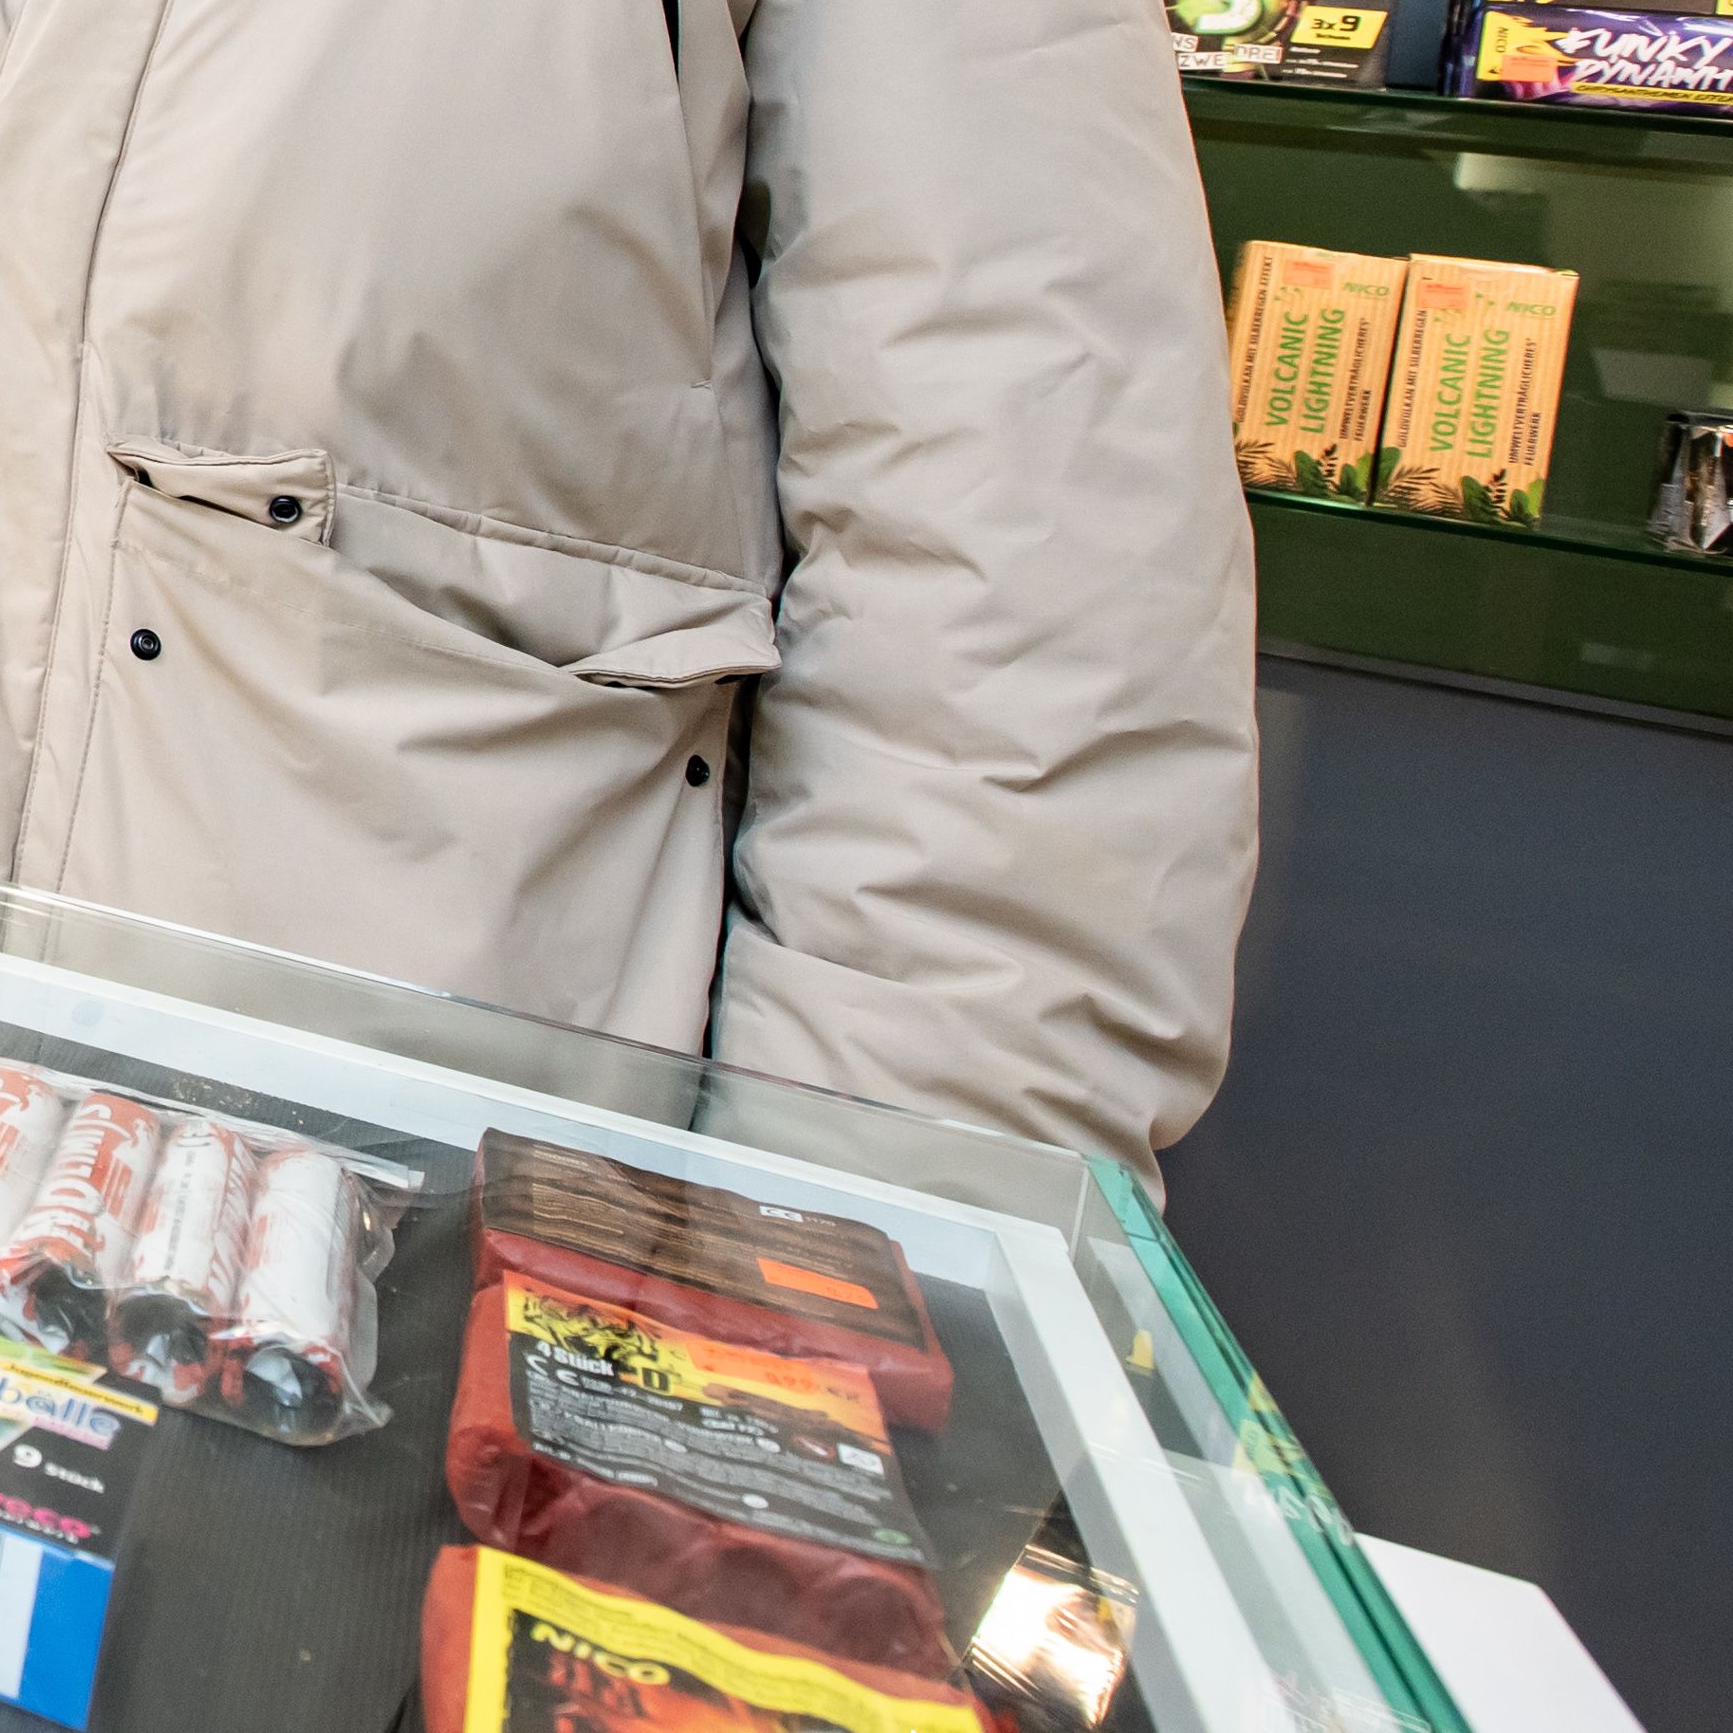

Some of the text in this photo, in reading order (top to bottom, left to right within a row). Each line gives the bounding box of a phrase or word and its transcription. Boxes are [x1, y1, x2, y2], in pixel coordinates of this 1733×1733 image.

[1340, 14, 1361, 32] 9
[1496, 26, 1509, 54] NICO
[1555, 27, 1733, 70] FUNKY
[1344, 281, 1390, 297] NICO
[1507, 301, 1557, 317] NICO
[1264, 312, 1310, 427] VOLCANIC
[1299, 307, 1347, 435] LIGHTNING
[1430, 332, 1472, 453] VOLCANIC
[1465, 328, 1510, 459] LIGHTNING
[12, 1443, 43, 1468] 9
[531, 1621, 671, 1686] NICO
